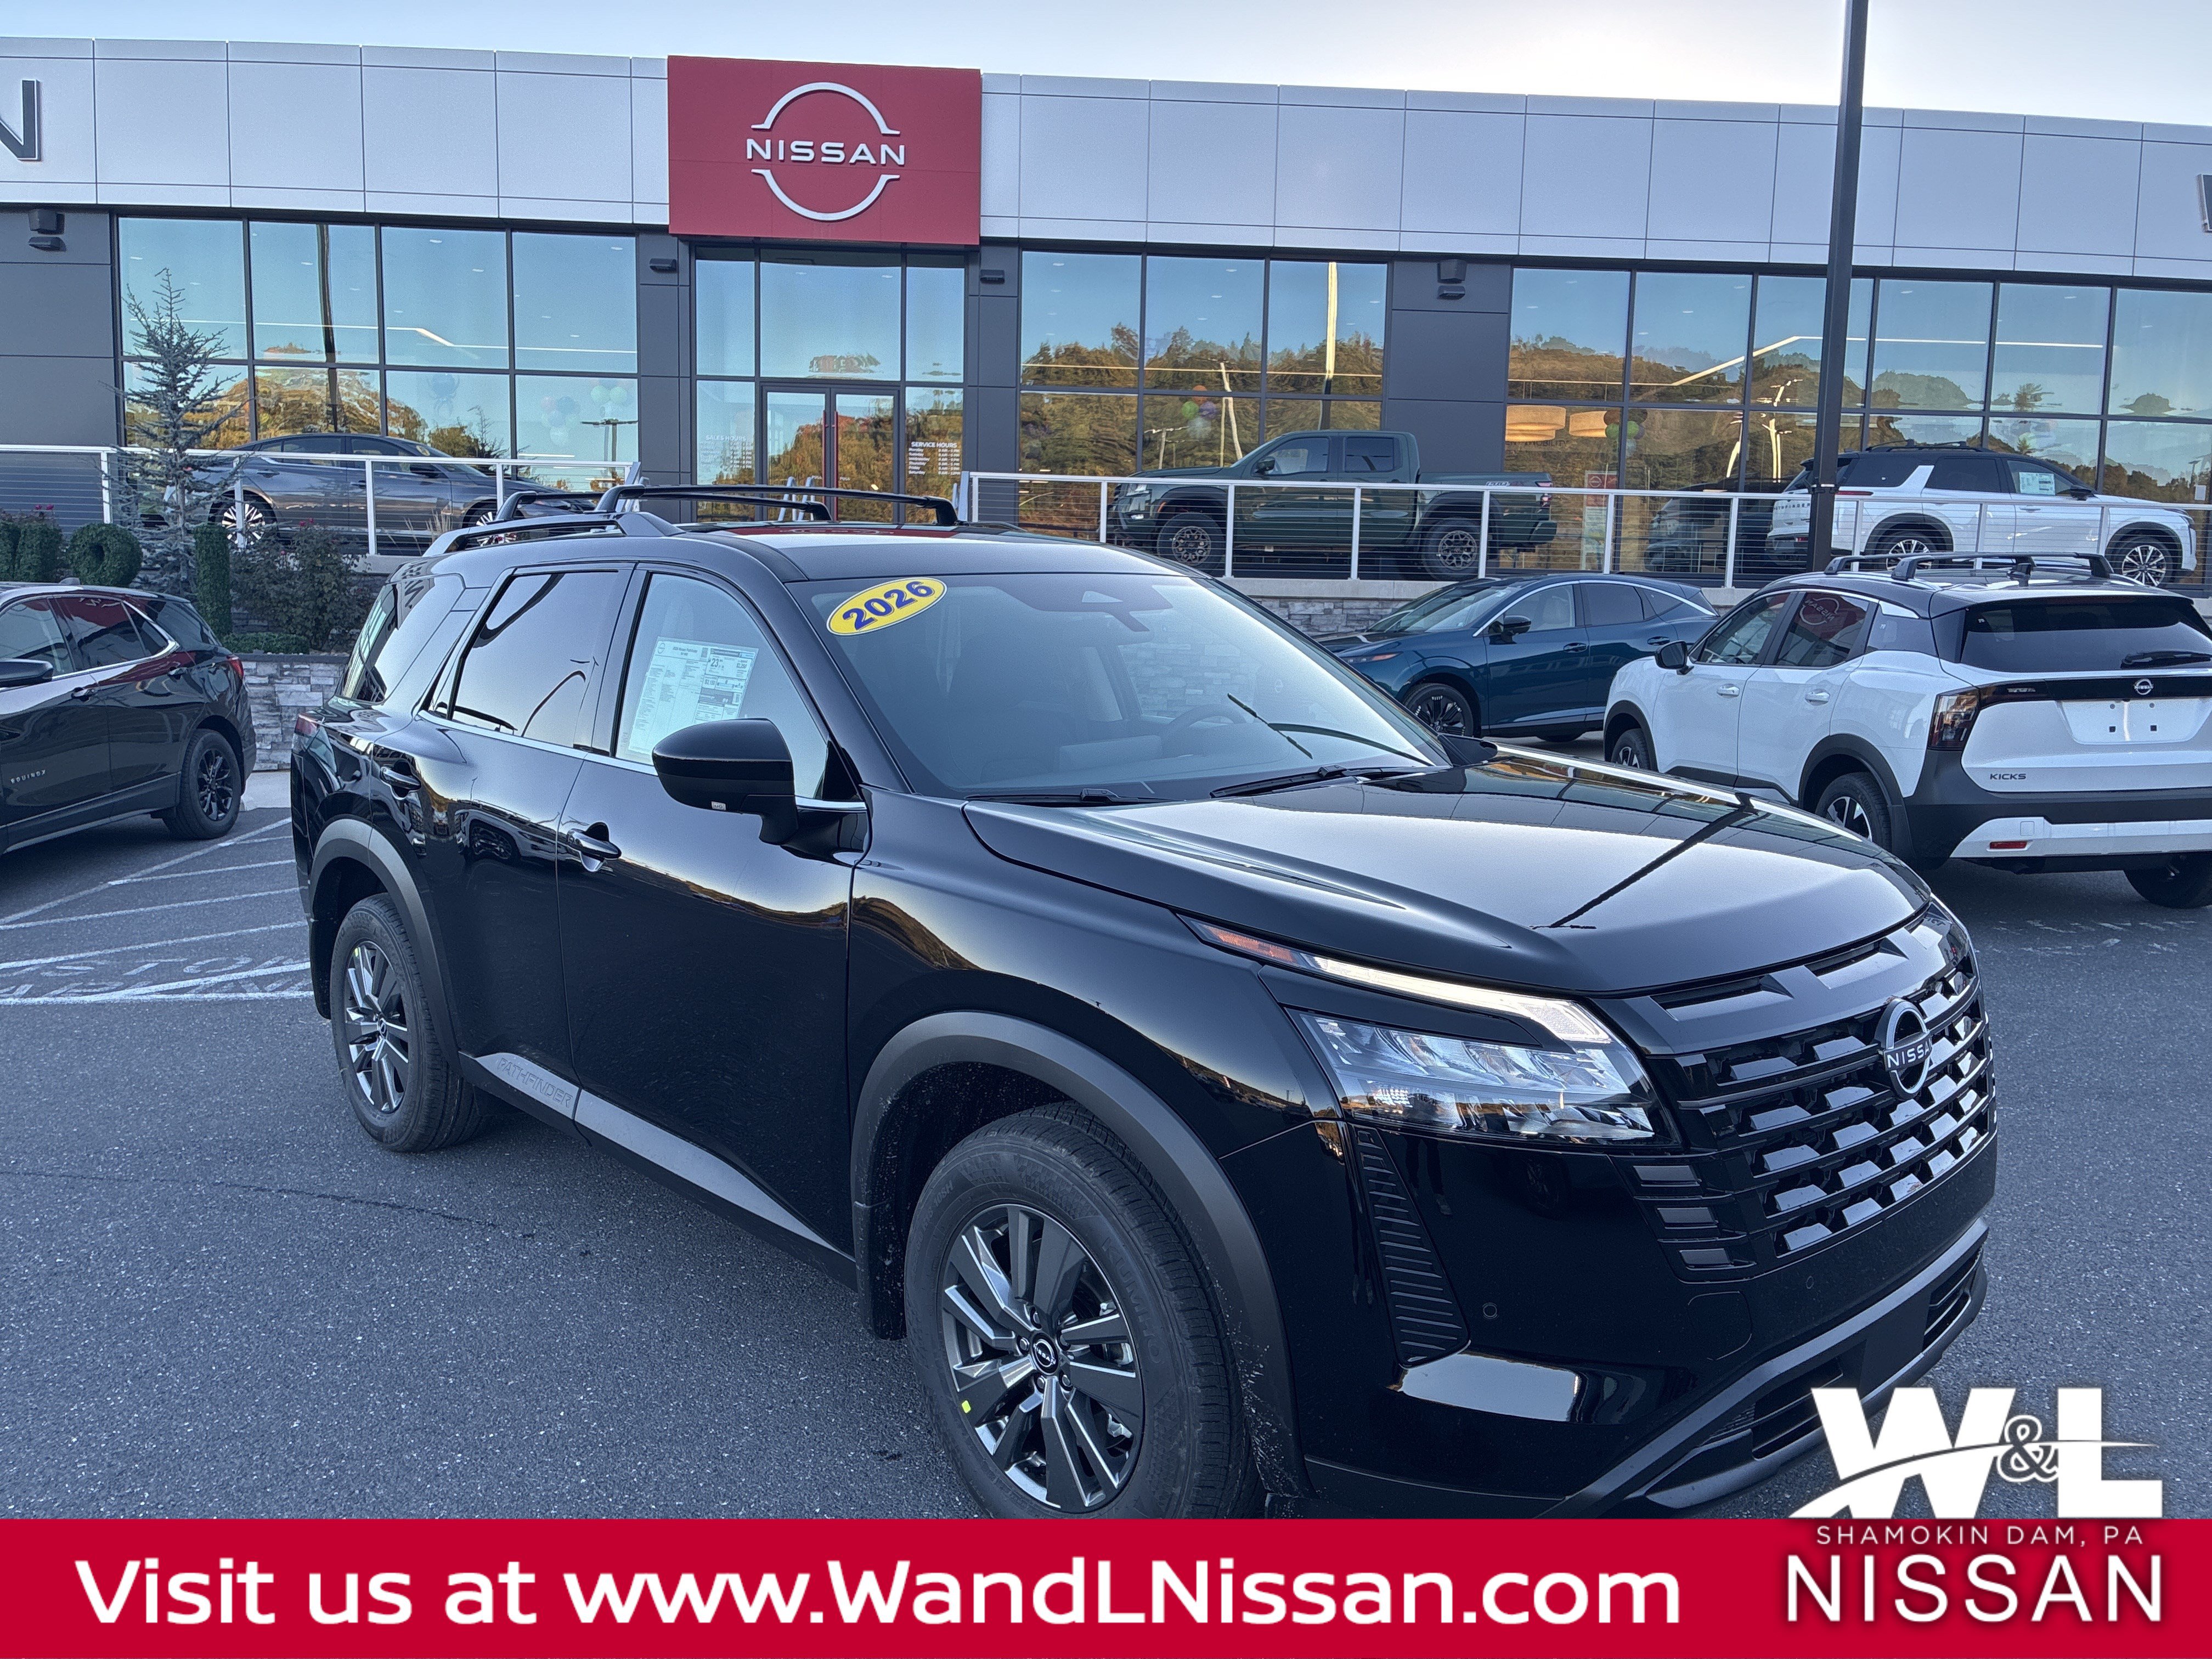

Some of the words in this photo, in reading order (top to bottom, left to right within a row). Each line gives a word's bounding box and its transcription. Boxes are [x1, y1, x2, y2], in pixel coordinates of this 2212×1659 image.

[746, 138, 905, 166] NISSAN
[842, 581, 935, 630] 2026
[10, 769, 46, 784] EQUINOX
[1887, 1038, 1933, 1068] NISSAN
[496, 1057, 574, 1109] PATHFINDER
[1102, 1236, 1164, 1364] KUMHO
[1033, 1343, 1056, 1364] NISSAN
